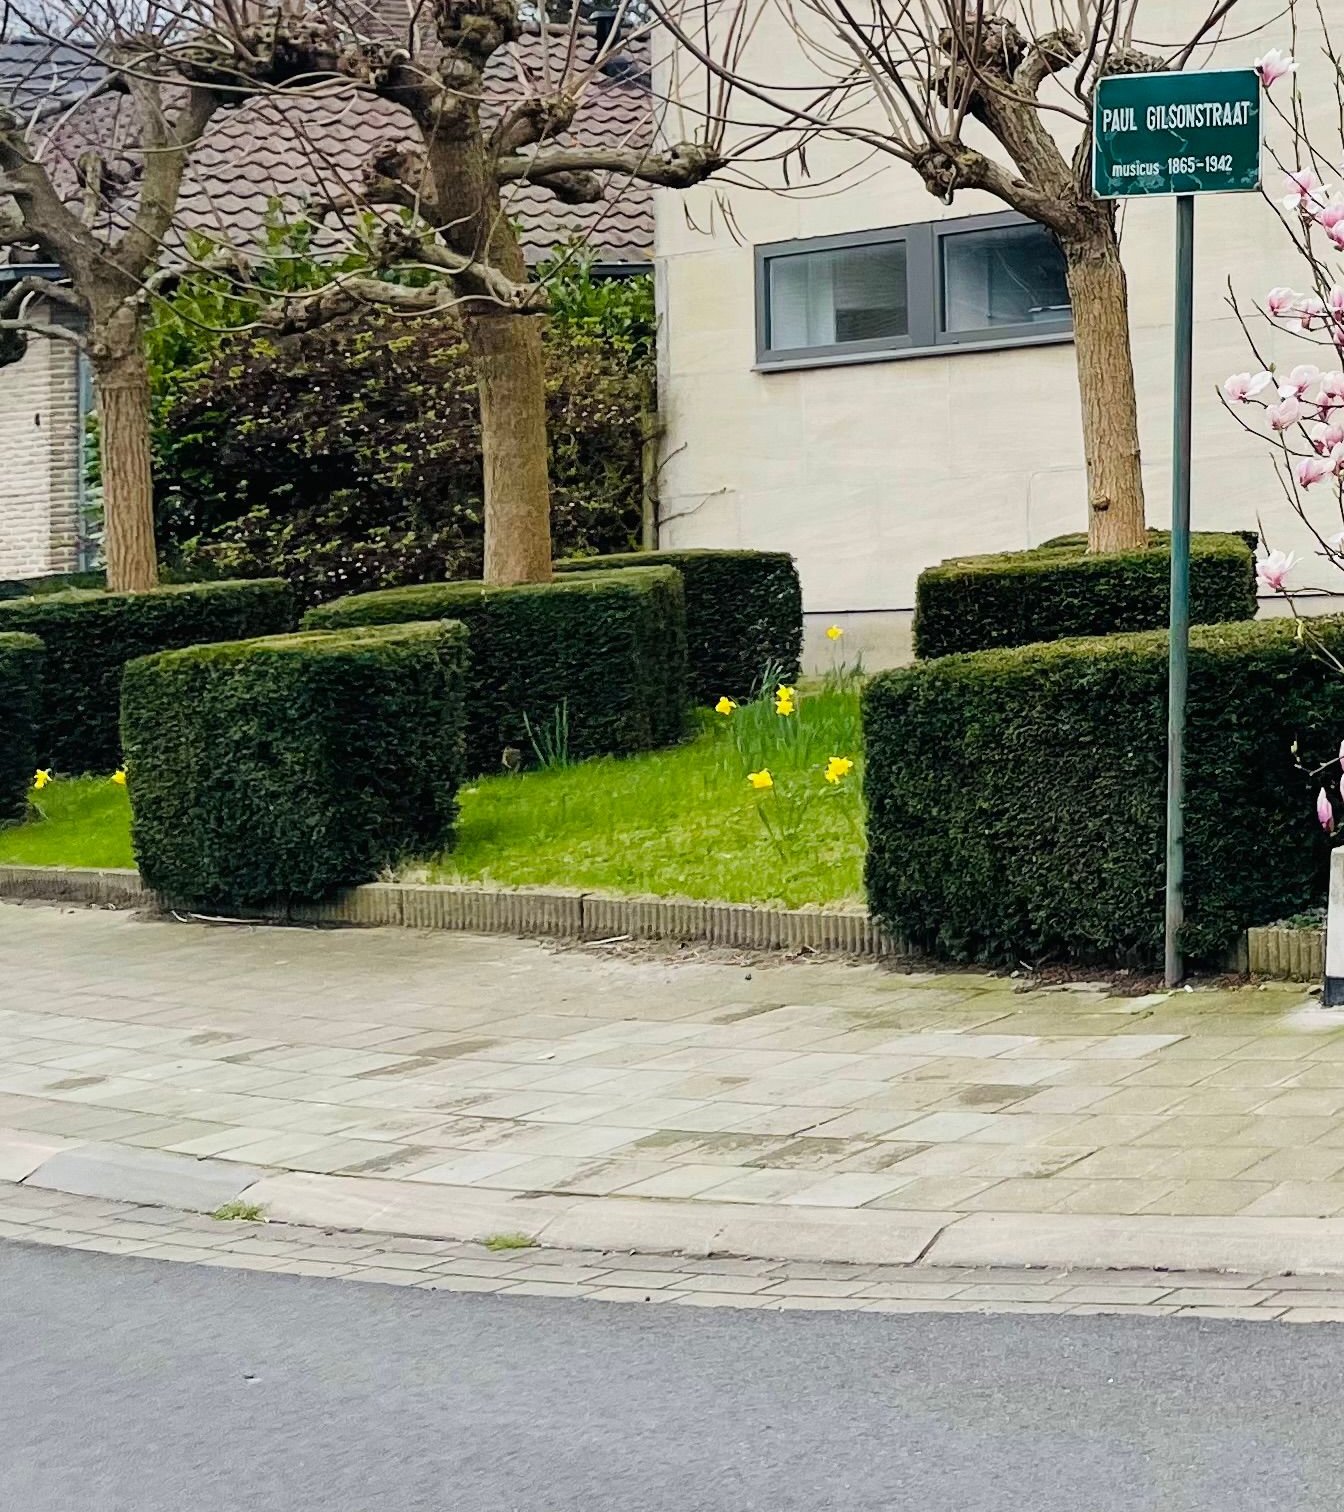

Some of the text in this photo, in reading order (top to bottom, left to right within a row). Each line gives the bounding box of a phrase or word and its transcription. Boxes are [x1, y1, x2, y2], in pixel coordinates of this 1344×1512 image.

[1102, 100, 1251, 133] PAUL GILSONSTRAAT
[1111, 155, 1233, 177] musicus 1865-1942
